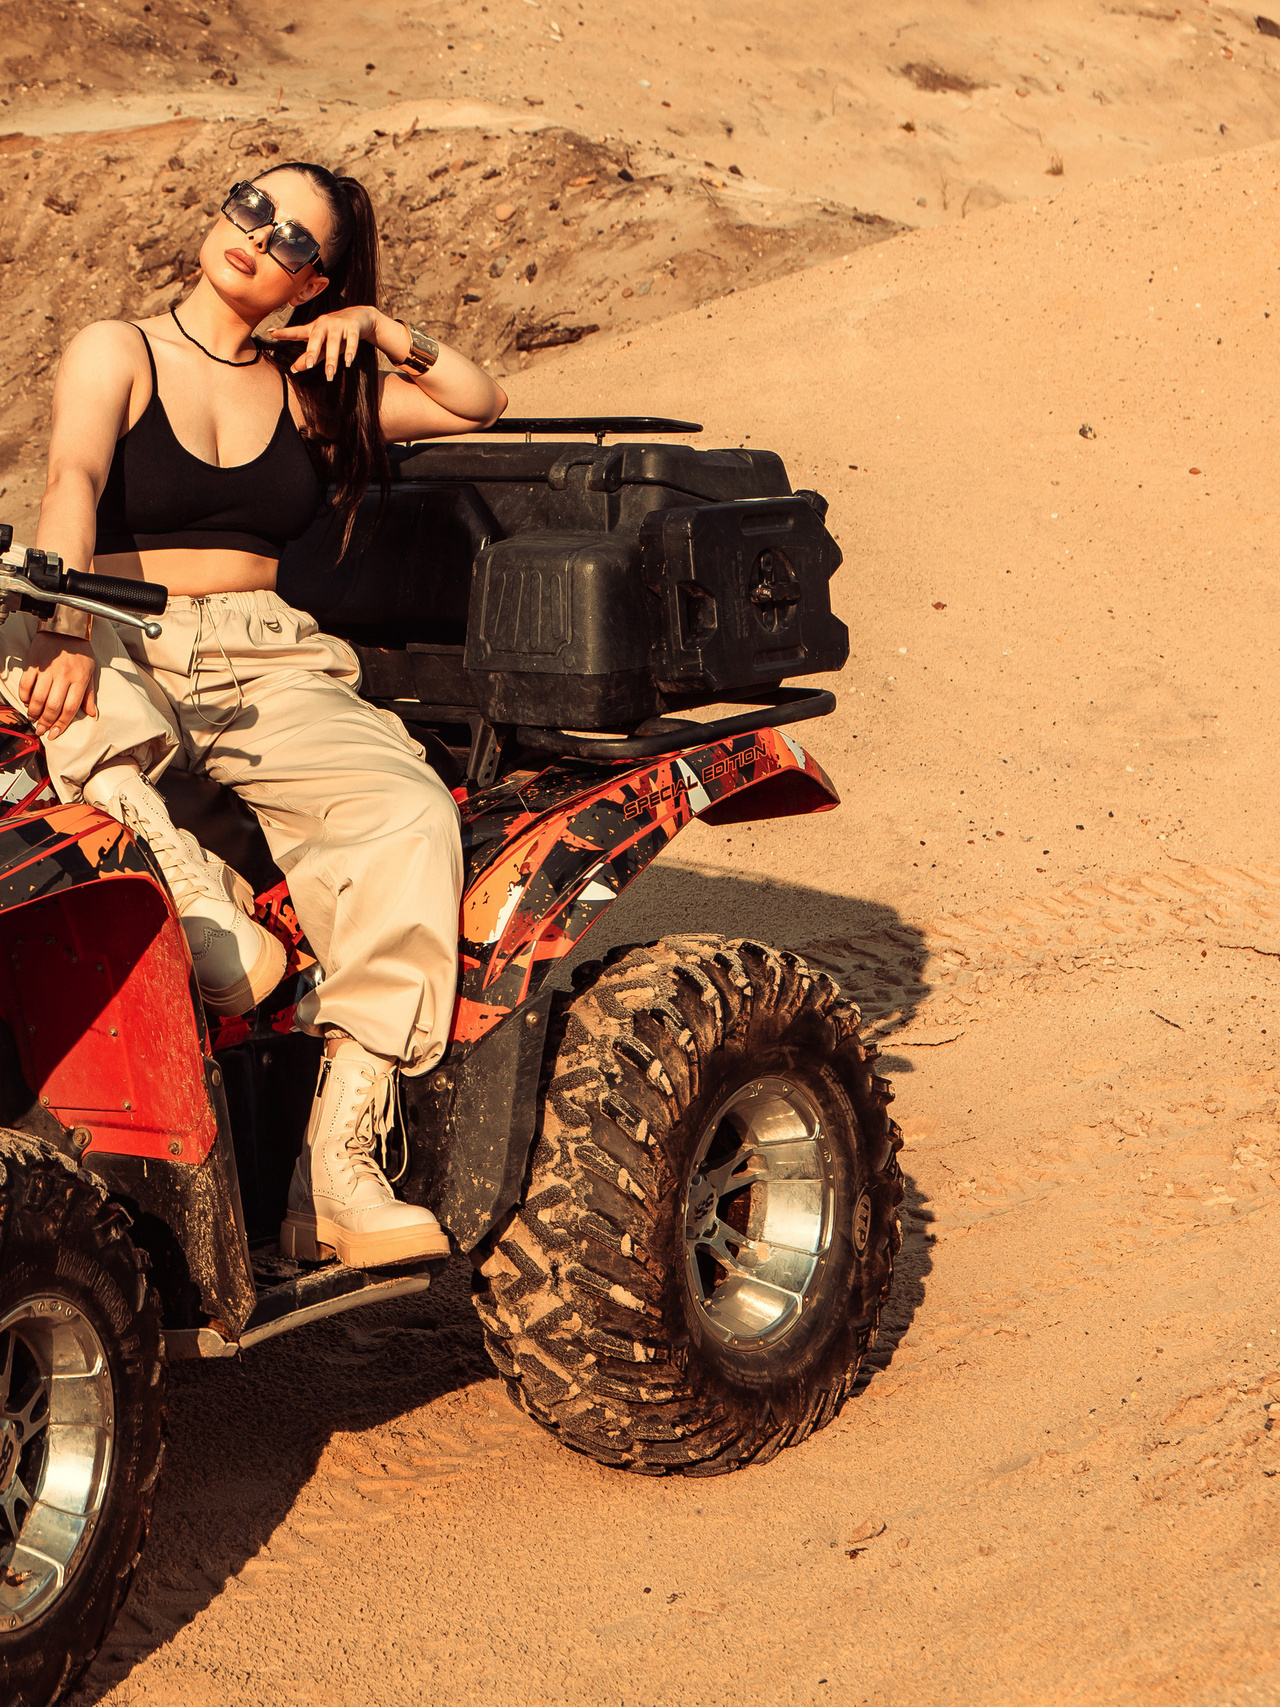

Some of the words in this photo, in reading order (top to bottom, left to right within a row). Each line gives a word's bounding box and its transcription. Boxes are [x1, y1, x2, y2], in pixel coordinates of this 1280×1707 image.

[623, 776, 699, 820] SPECIAL
[702, 743, 768, 784] EDITION
[857, 1201, 870, 1244] ITP
